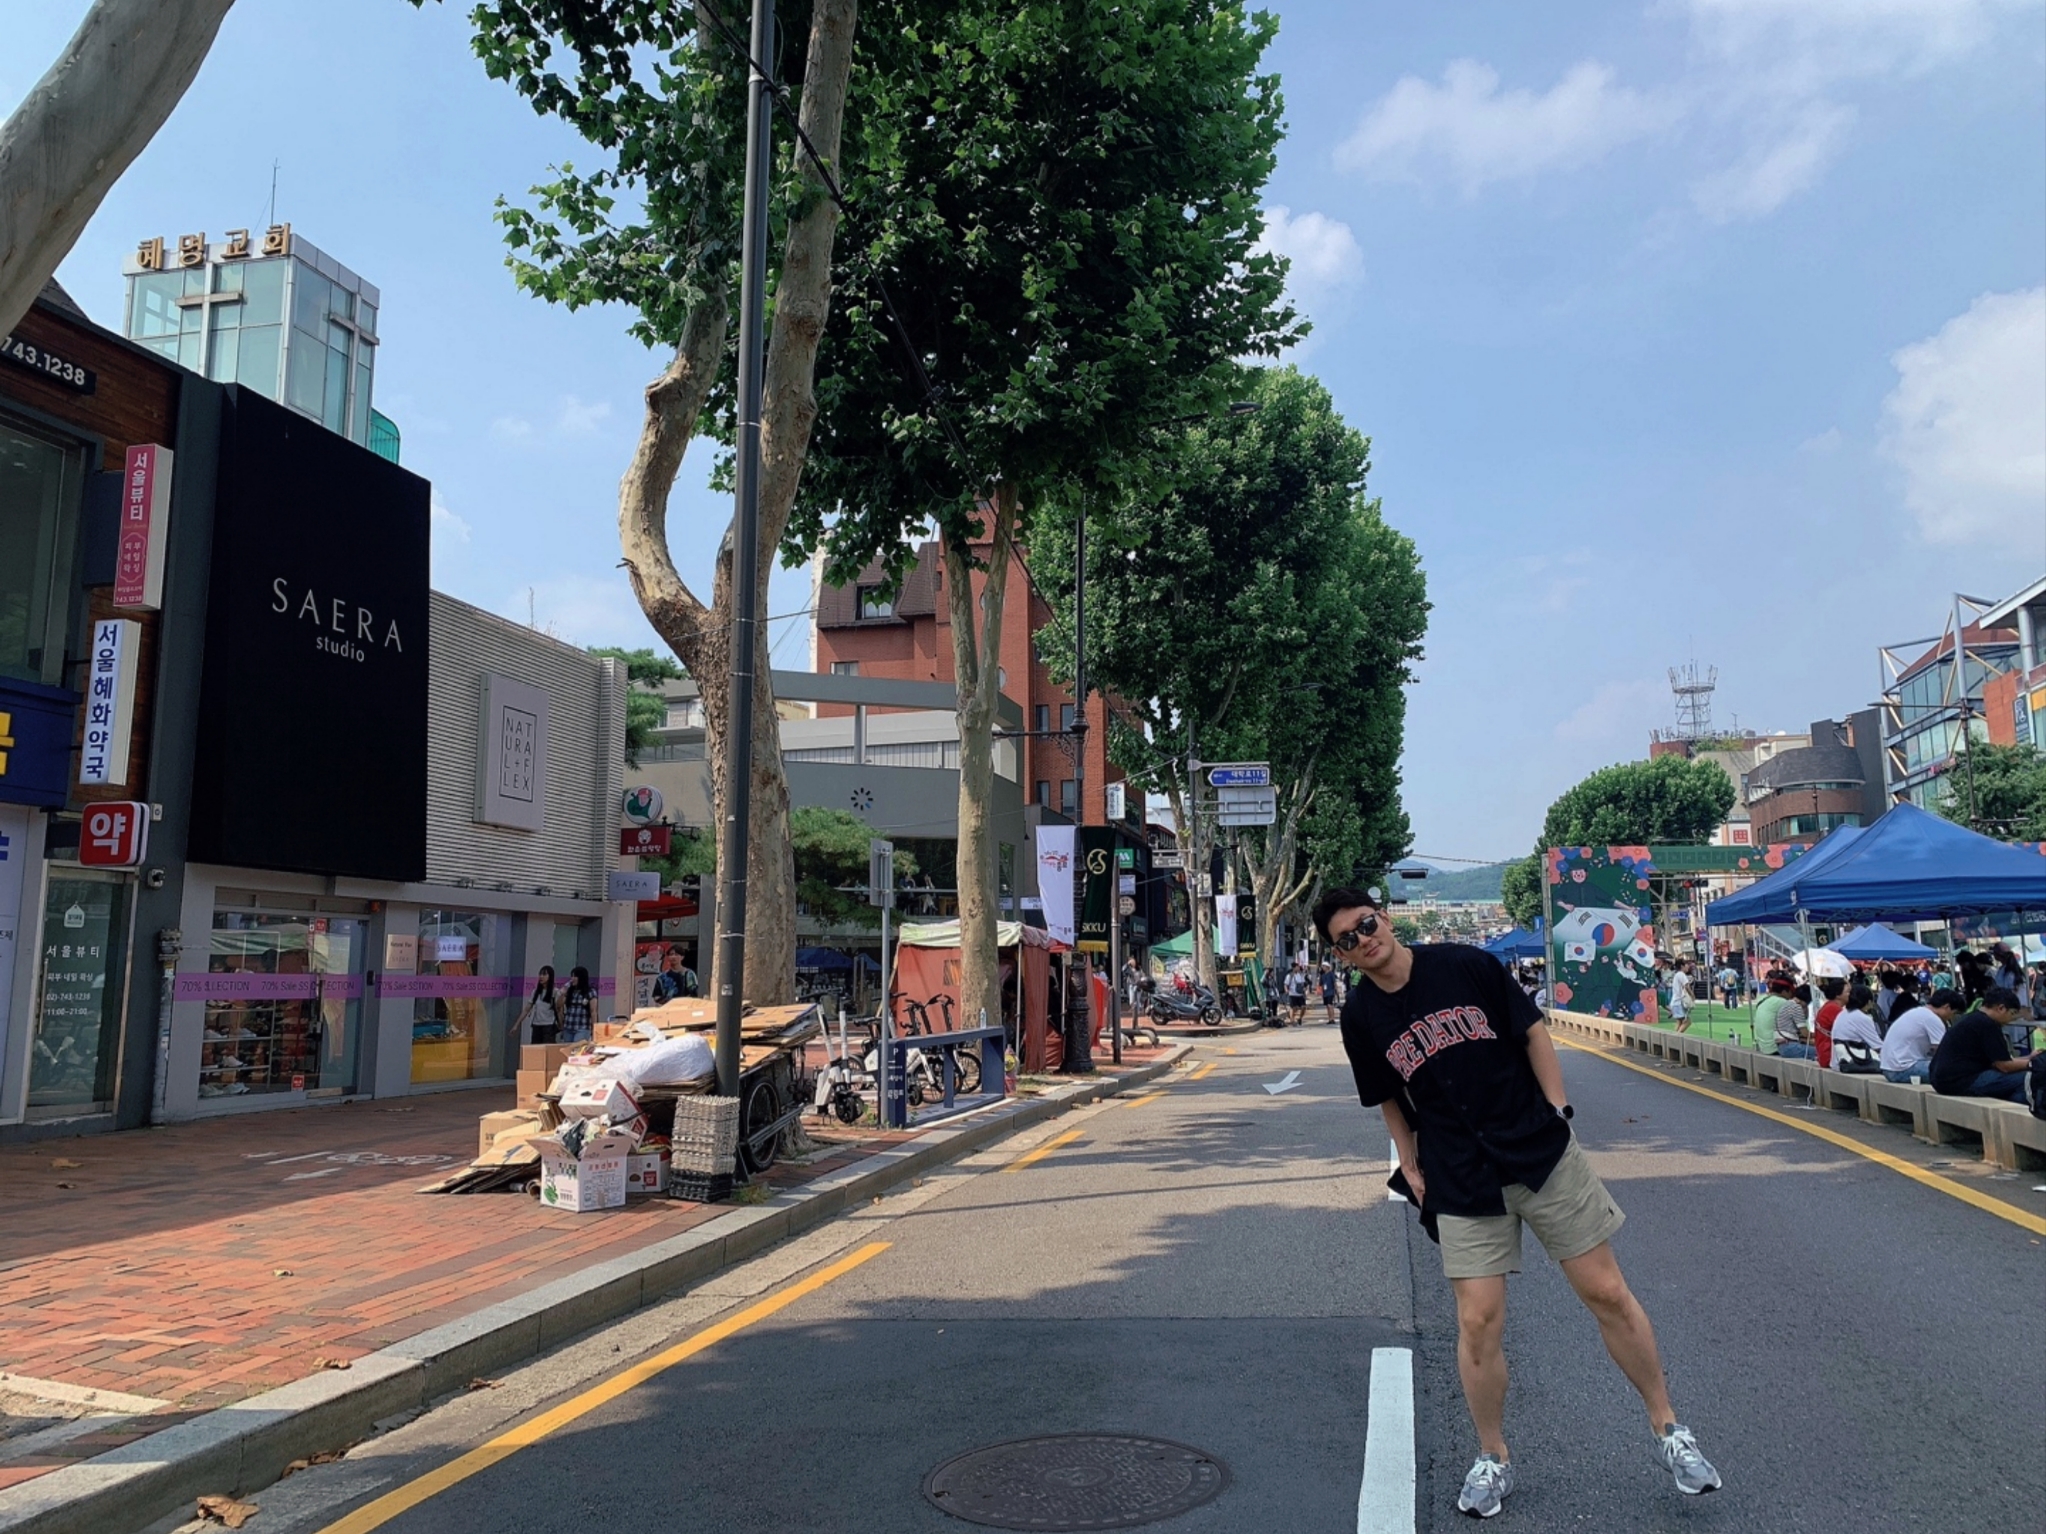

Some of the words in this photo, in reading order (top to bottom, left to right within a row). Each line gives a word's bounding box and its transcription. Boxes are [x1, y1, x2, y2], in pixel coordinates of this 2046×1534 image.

[137, 222, 291, 270] 혜명교회
[130, 453, 147, 520] 서울뷰티
[272, 577, 402, 653] SAERA
[316, 636, 365, 662] studio
[86, 624, 118, 778] 서울혜화약국
[506, 717, 532, 737] NAT
[505, 735, 531, 756] URA
[503, 771, 530, 791] LEX
[89, 812, 127, 856] 약
[1081, 922, 1107, 933] SKKU
[46, 945, 100, 958] 서울뷰티
[181, 981, 202, 992] 70%
[261, 981, 279, 991] 70%
[280, 981, 297, 991] Sale
